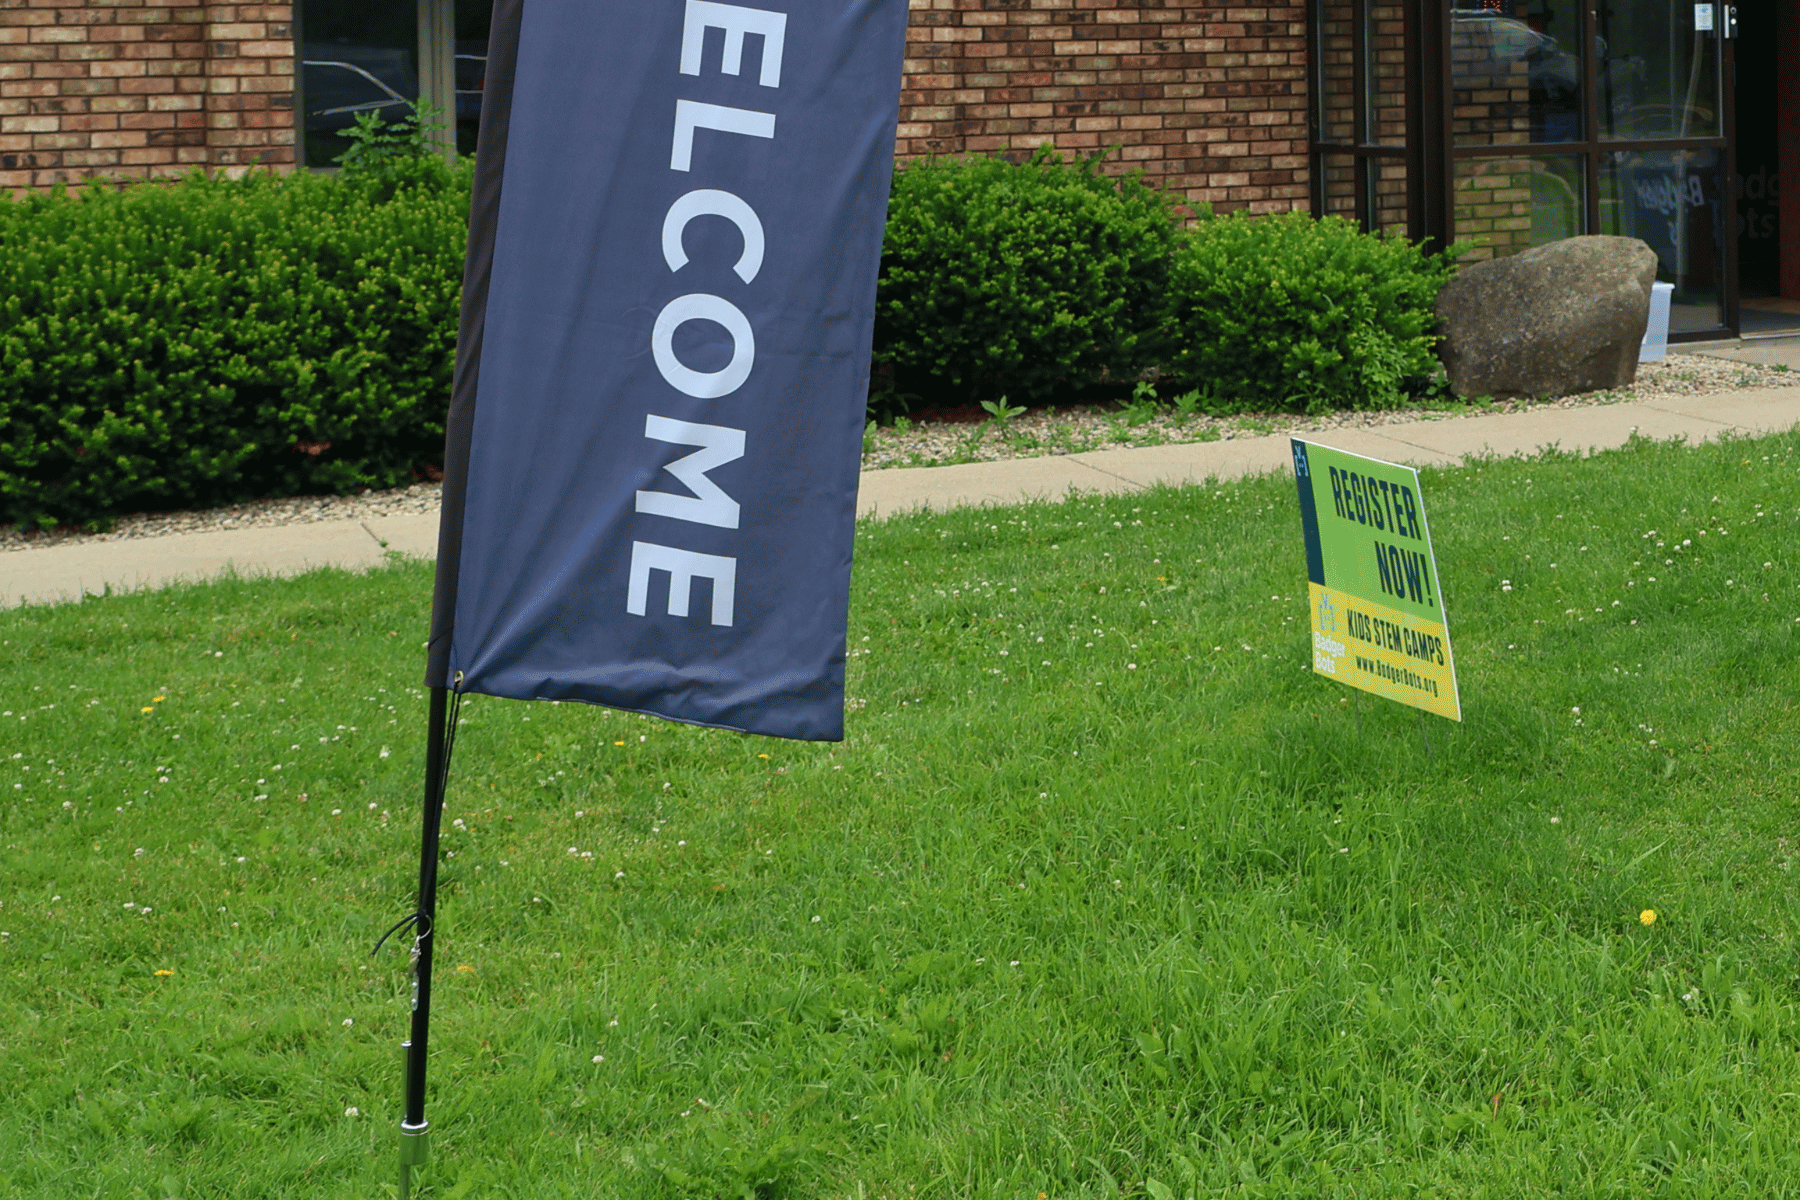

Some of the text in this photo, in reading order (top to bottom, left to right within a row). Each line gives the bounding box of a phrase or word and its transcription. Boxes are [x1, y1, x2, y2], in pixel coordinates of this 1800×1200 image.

[1328, 465, 1422, 541] REGISTER
[1374, 540, 1434, 608] NOW!
[1314, 630, 1346, 658] Badger
[1315, 650, 1336, 674] Bots
[1347, 608, 1444, 666] KIDS STEM CAMPS
